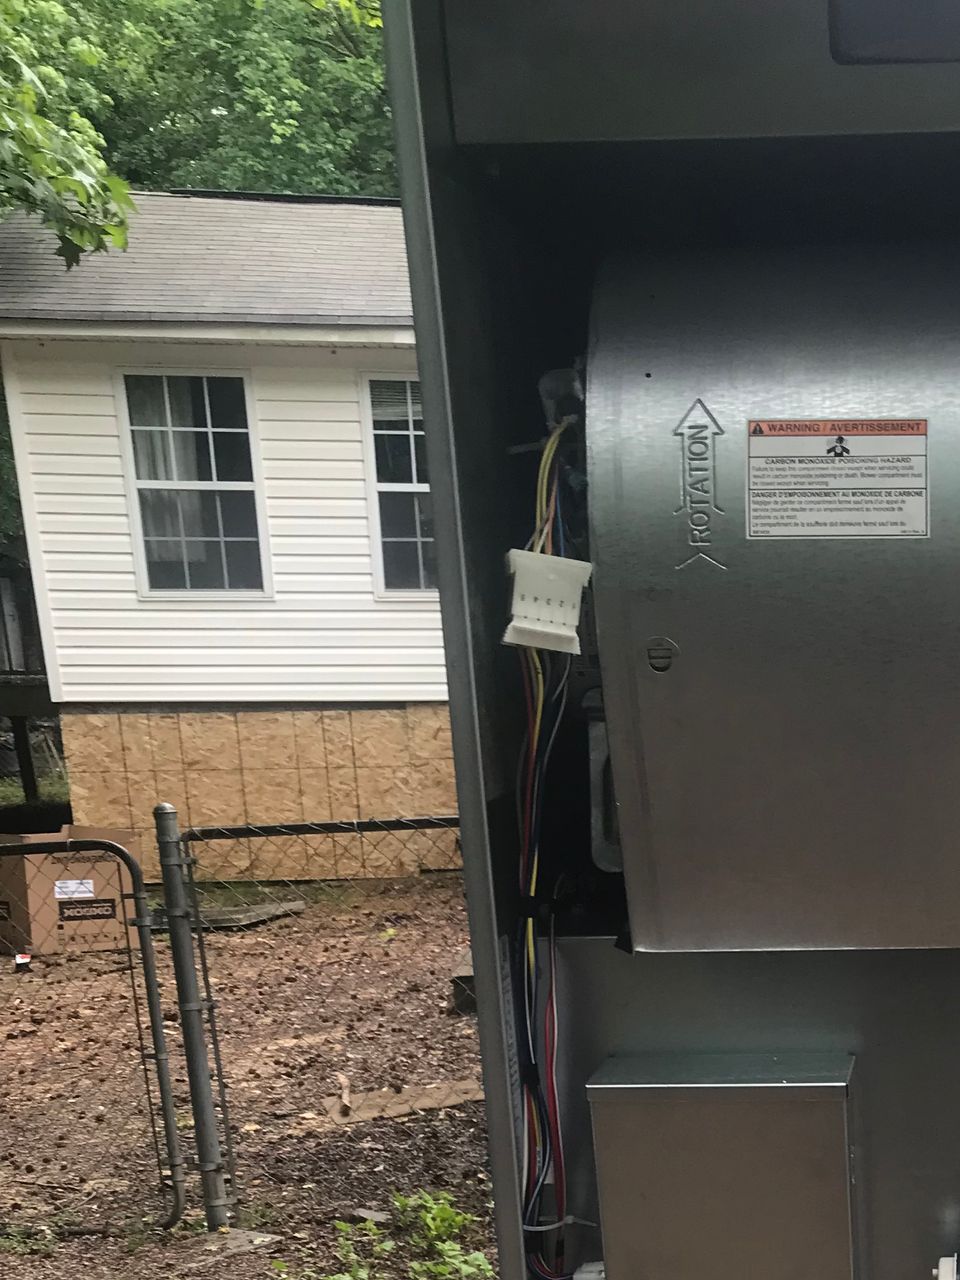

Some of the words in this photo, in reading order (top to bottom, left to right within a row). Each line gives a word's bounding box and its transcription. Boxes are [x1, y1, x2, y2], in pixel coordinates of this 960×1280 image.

[768, 423, 820, 432] WARNING
[829, 422, 921, 432] AVERTISSEMENT
[688, 424, 711, 546] ROTATION
